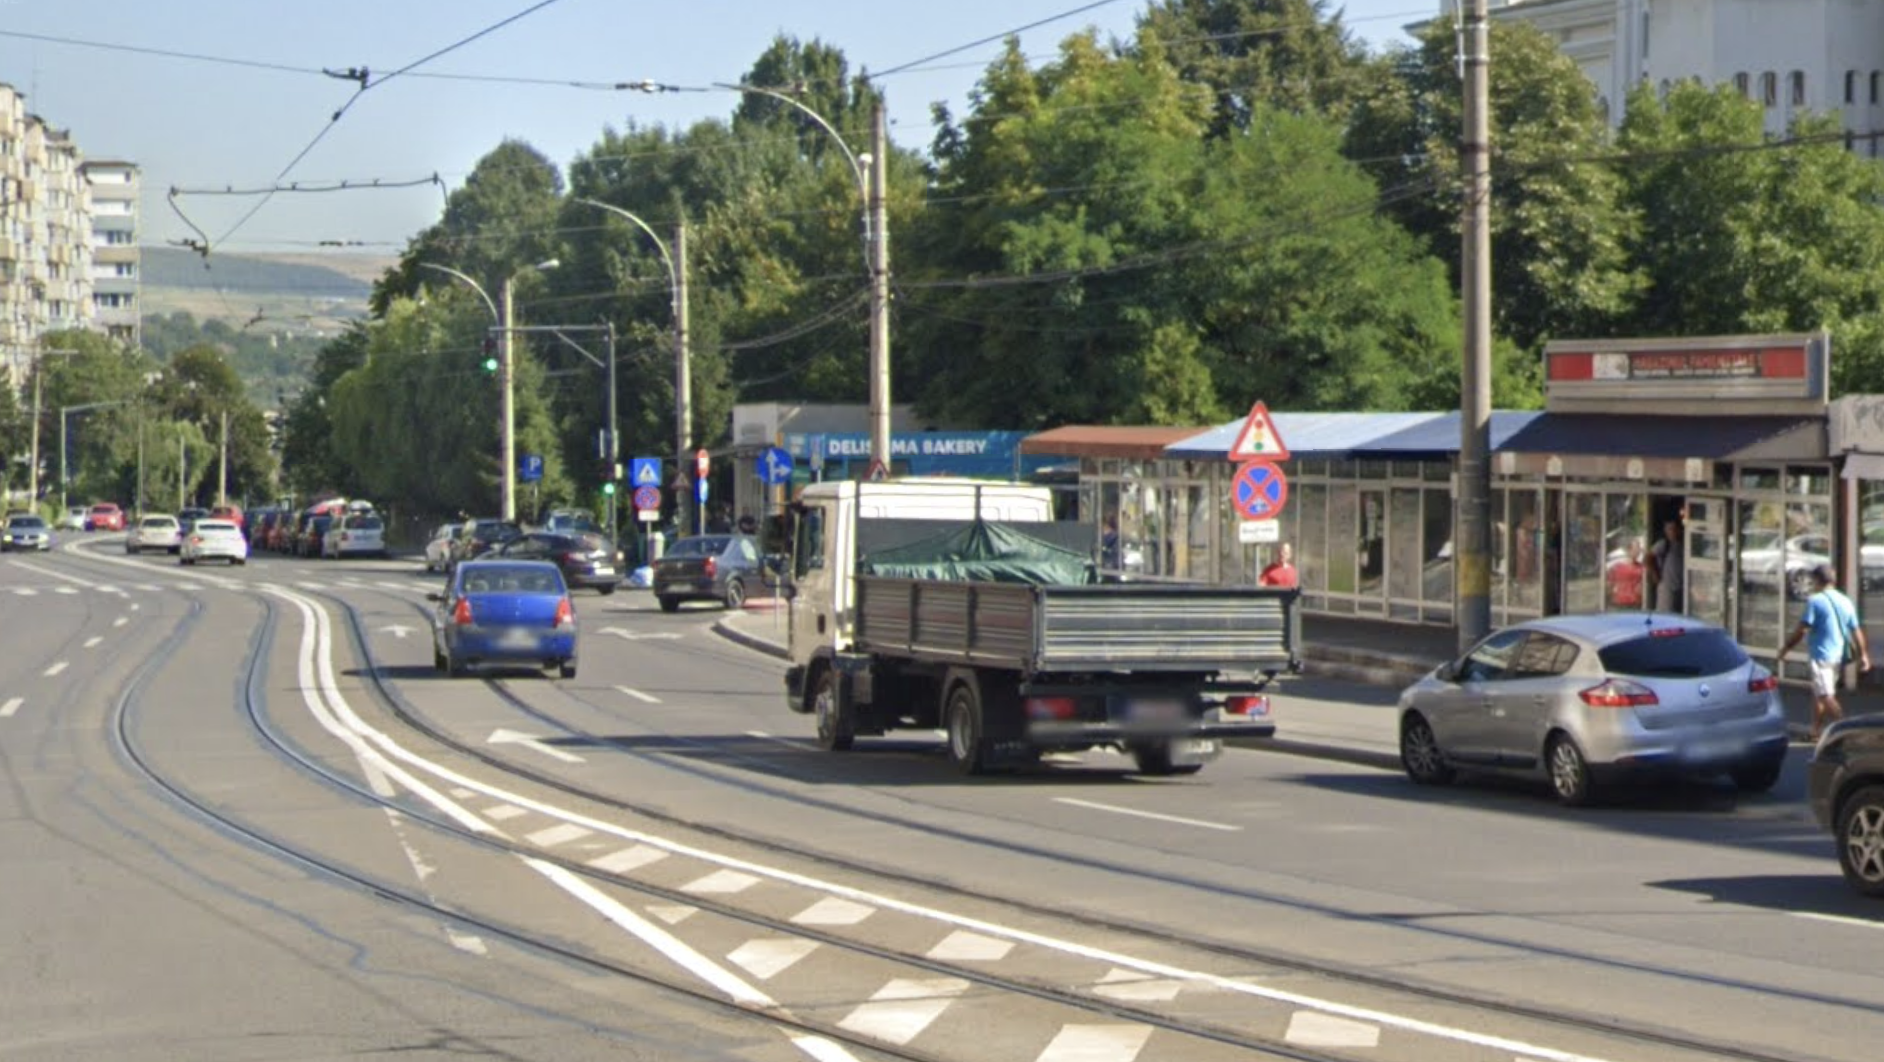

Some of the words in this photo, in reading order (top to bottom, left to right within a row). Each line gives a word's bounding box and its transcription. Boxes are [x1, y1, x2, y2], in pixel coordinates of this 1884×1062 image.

[829, 439, 919, 455] DELISMA
[923, 439, 987, 455] BAKERY
[529, 456, 541, 472] P
